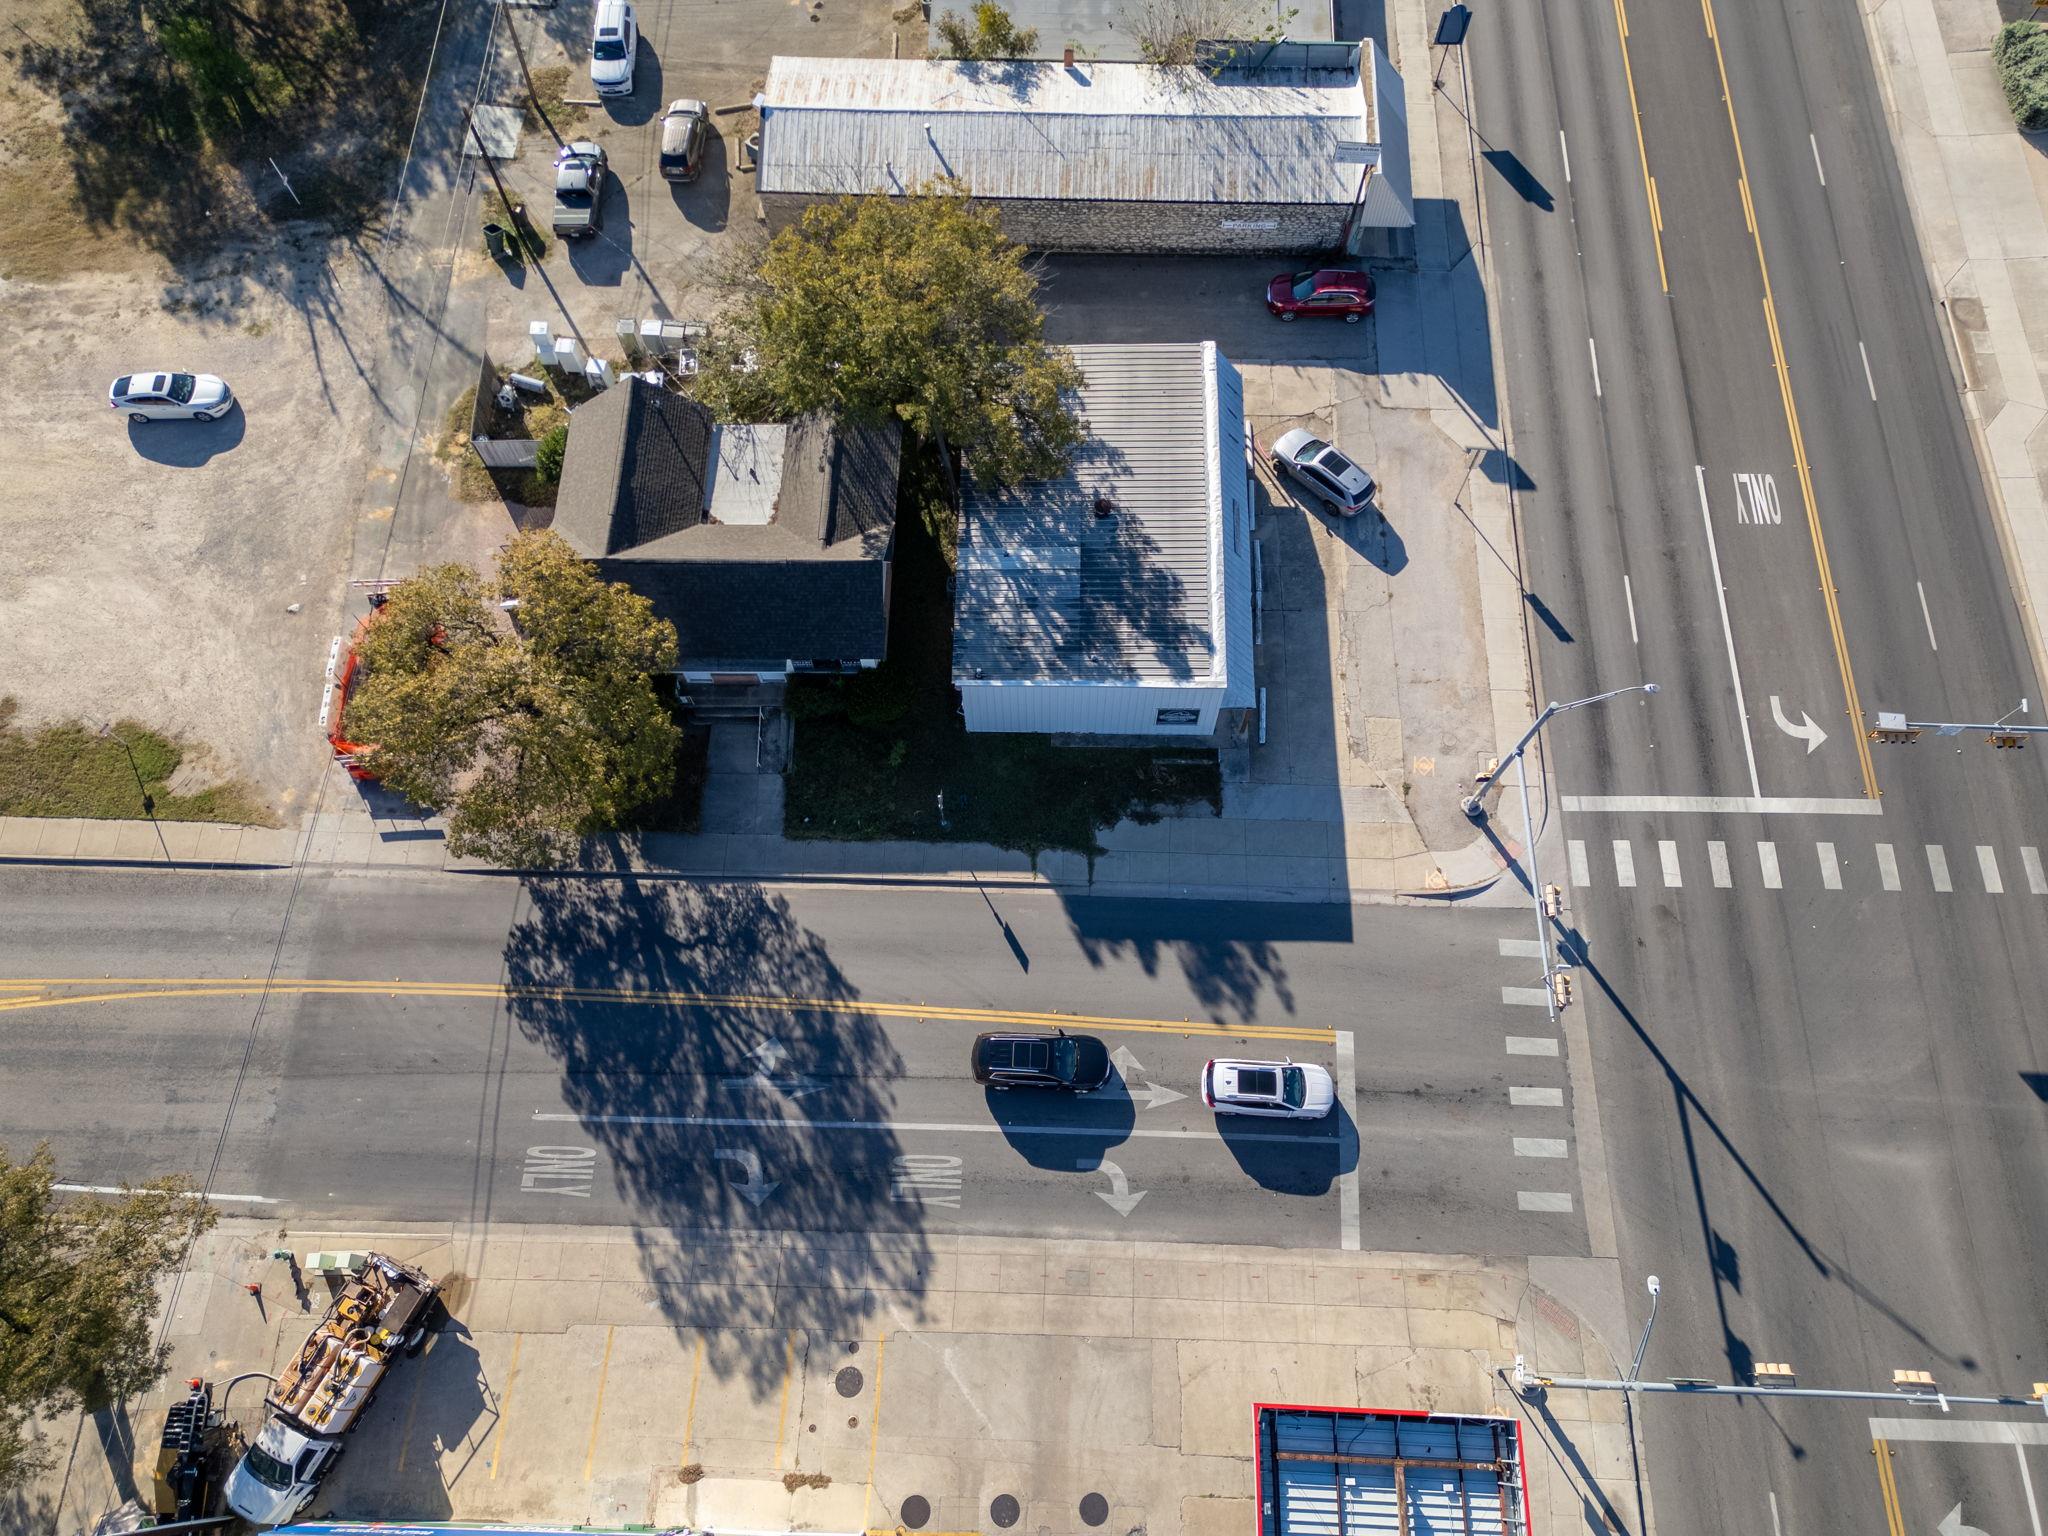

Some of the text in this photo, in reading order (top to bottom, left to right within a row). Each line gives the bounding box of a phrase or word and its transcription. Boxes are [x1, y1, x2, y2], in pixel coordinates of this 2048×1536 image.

[1732, 473, 1782, 525] ONLY
[520, 1145, 597, 1198] ONLY
[890, 1154, 963, 1209] ONLY
